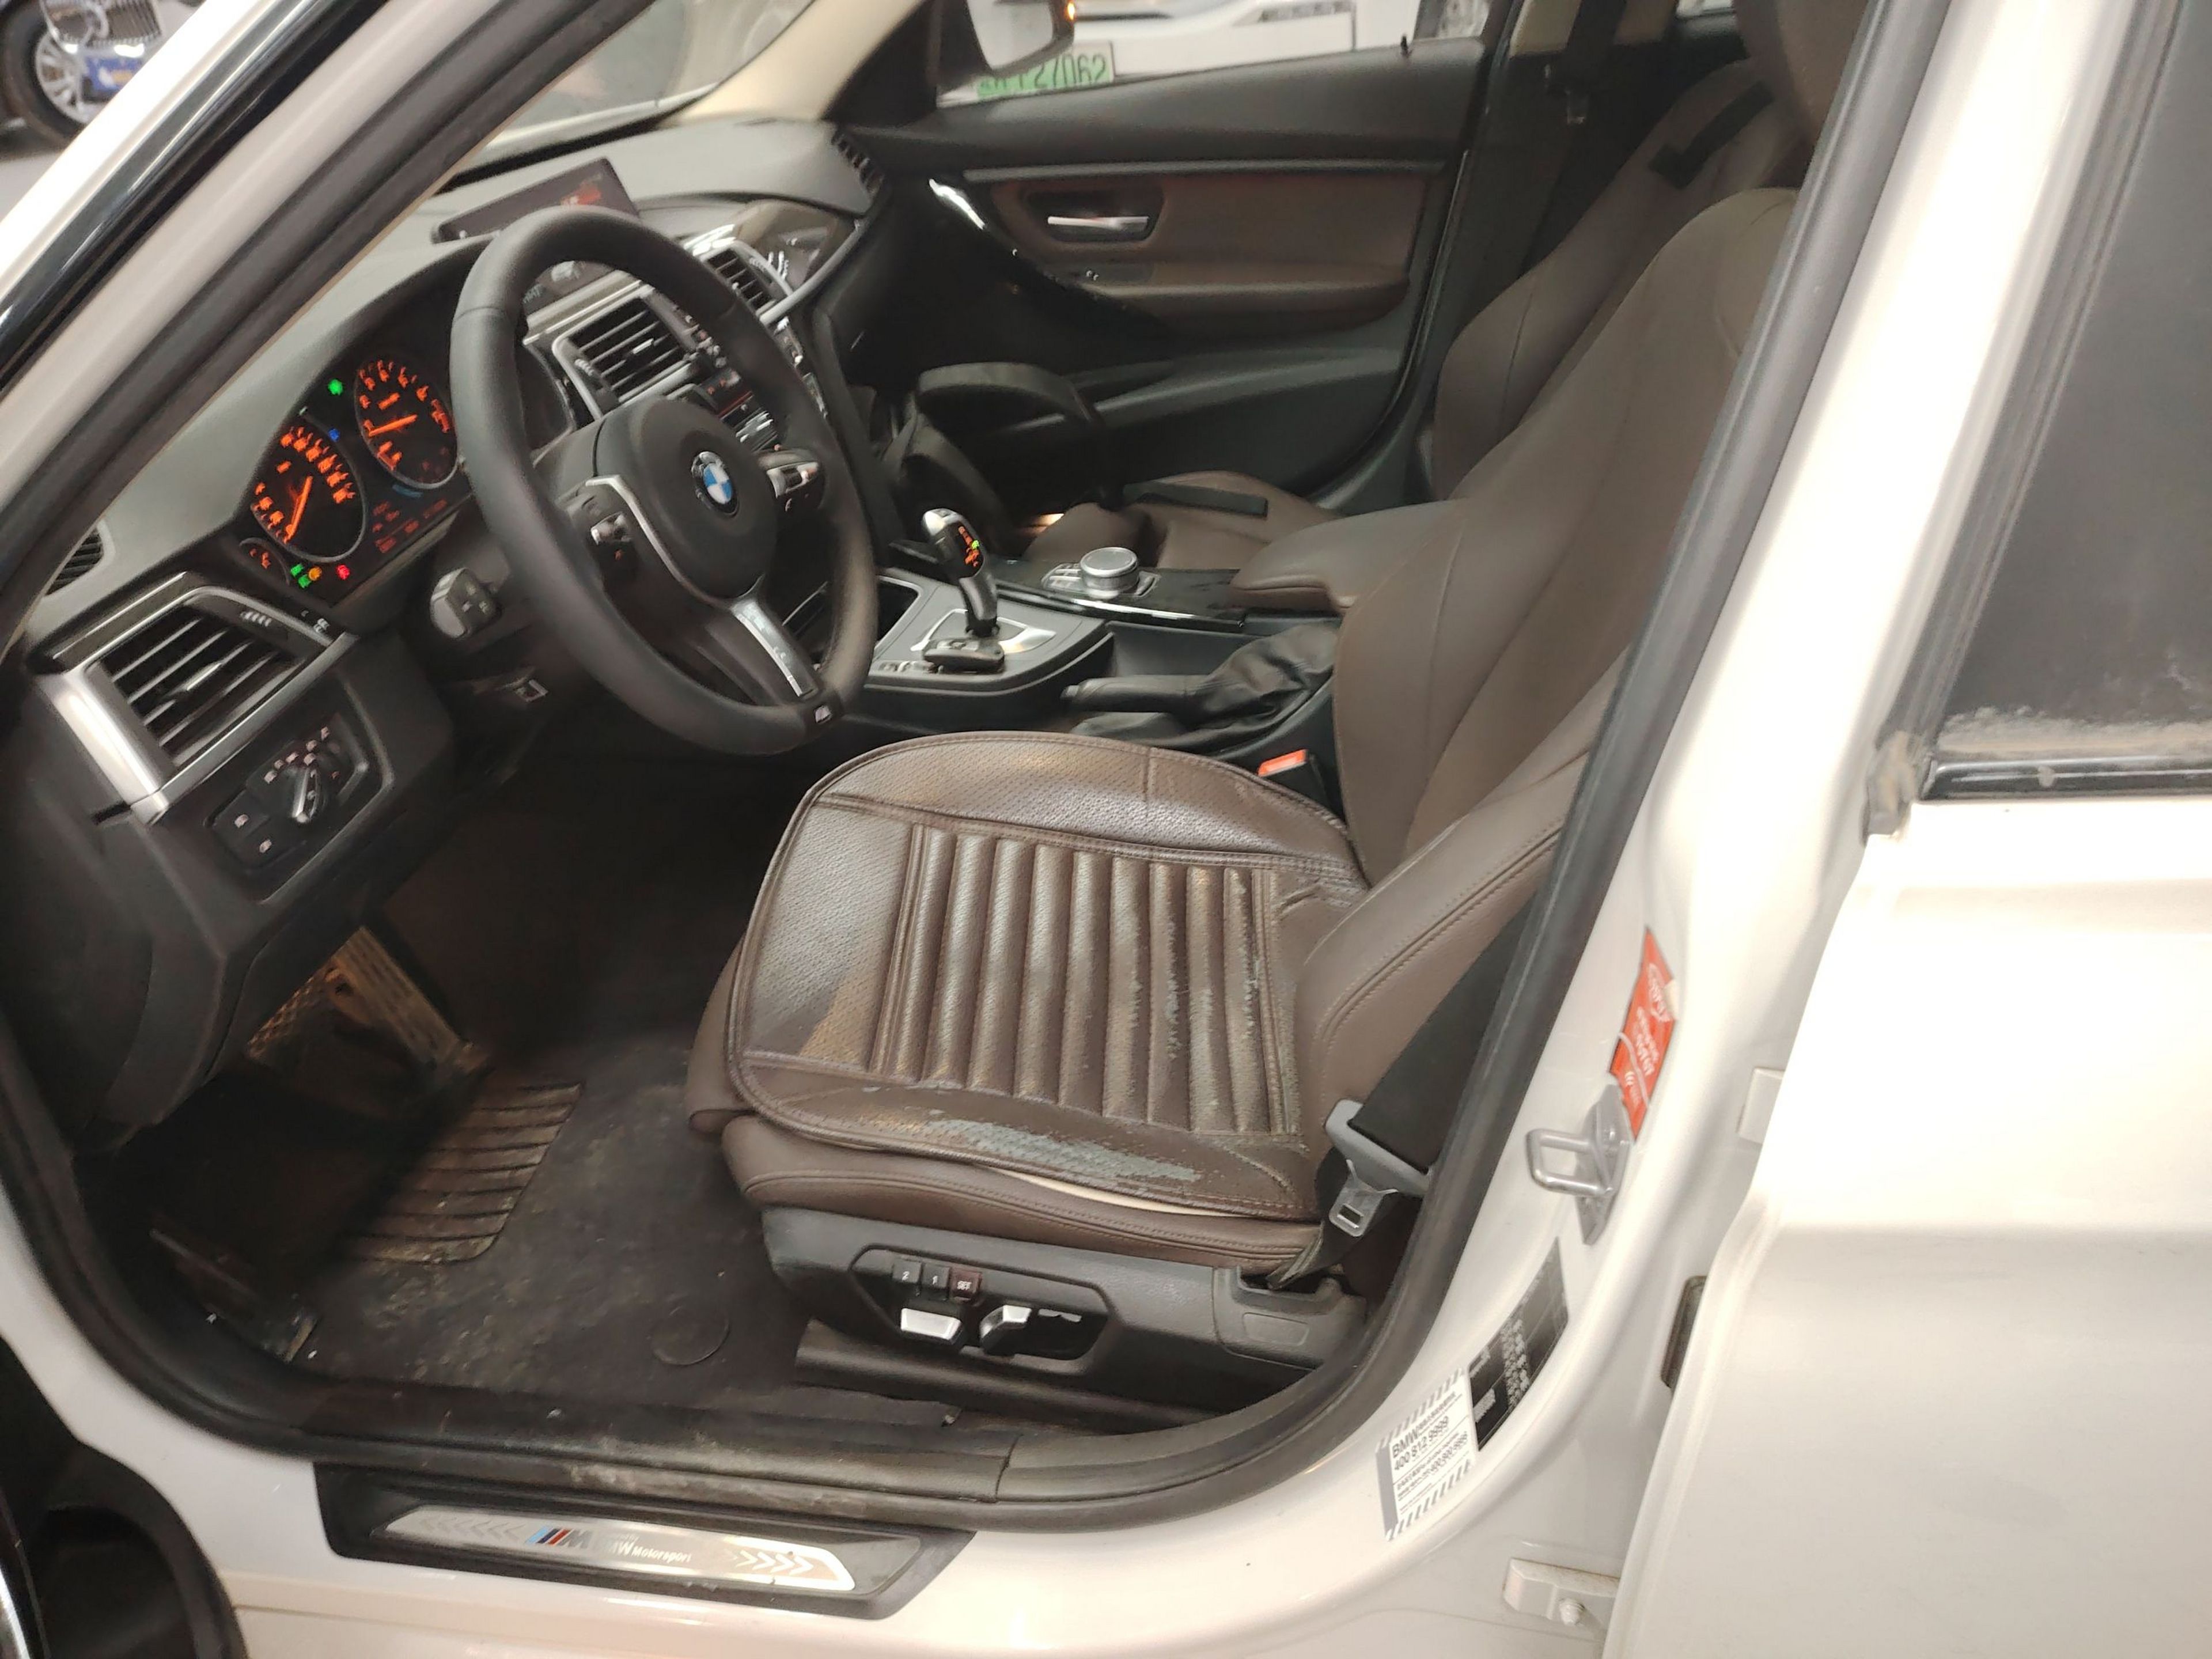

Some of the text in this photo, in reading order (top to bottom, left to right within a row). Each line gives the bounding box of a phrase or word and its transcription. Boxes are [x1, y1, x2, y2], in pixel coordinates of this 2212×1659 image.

[902, 1271, 910, 1282] 2
[931, 1275, 939, 1286] 1
[1392, 1426, 1419, 1459] BMW
